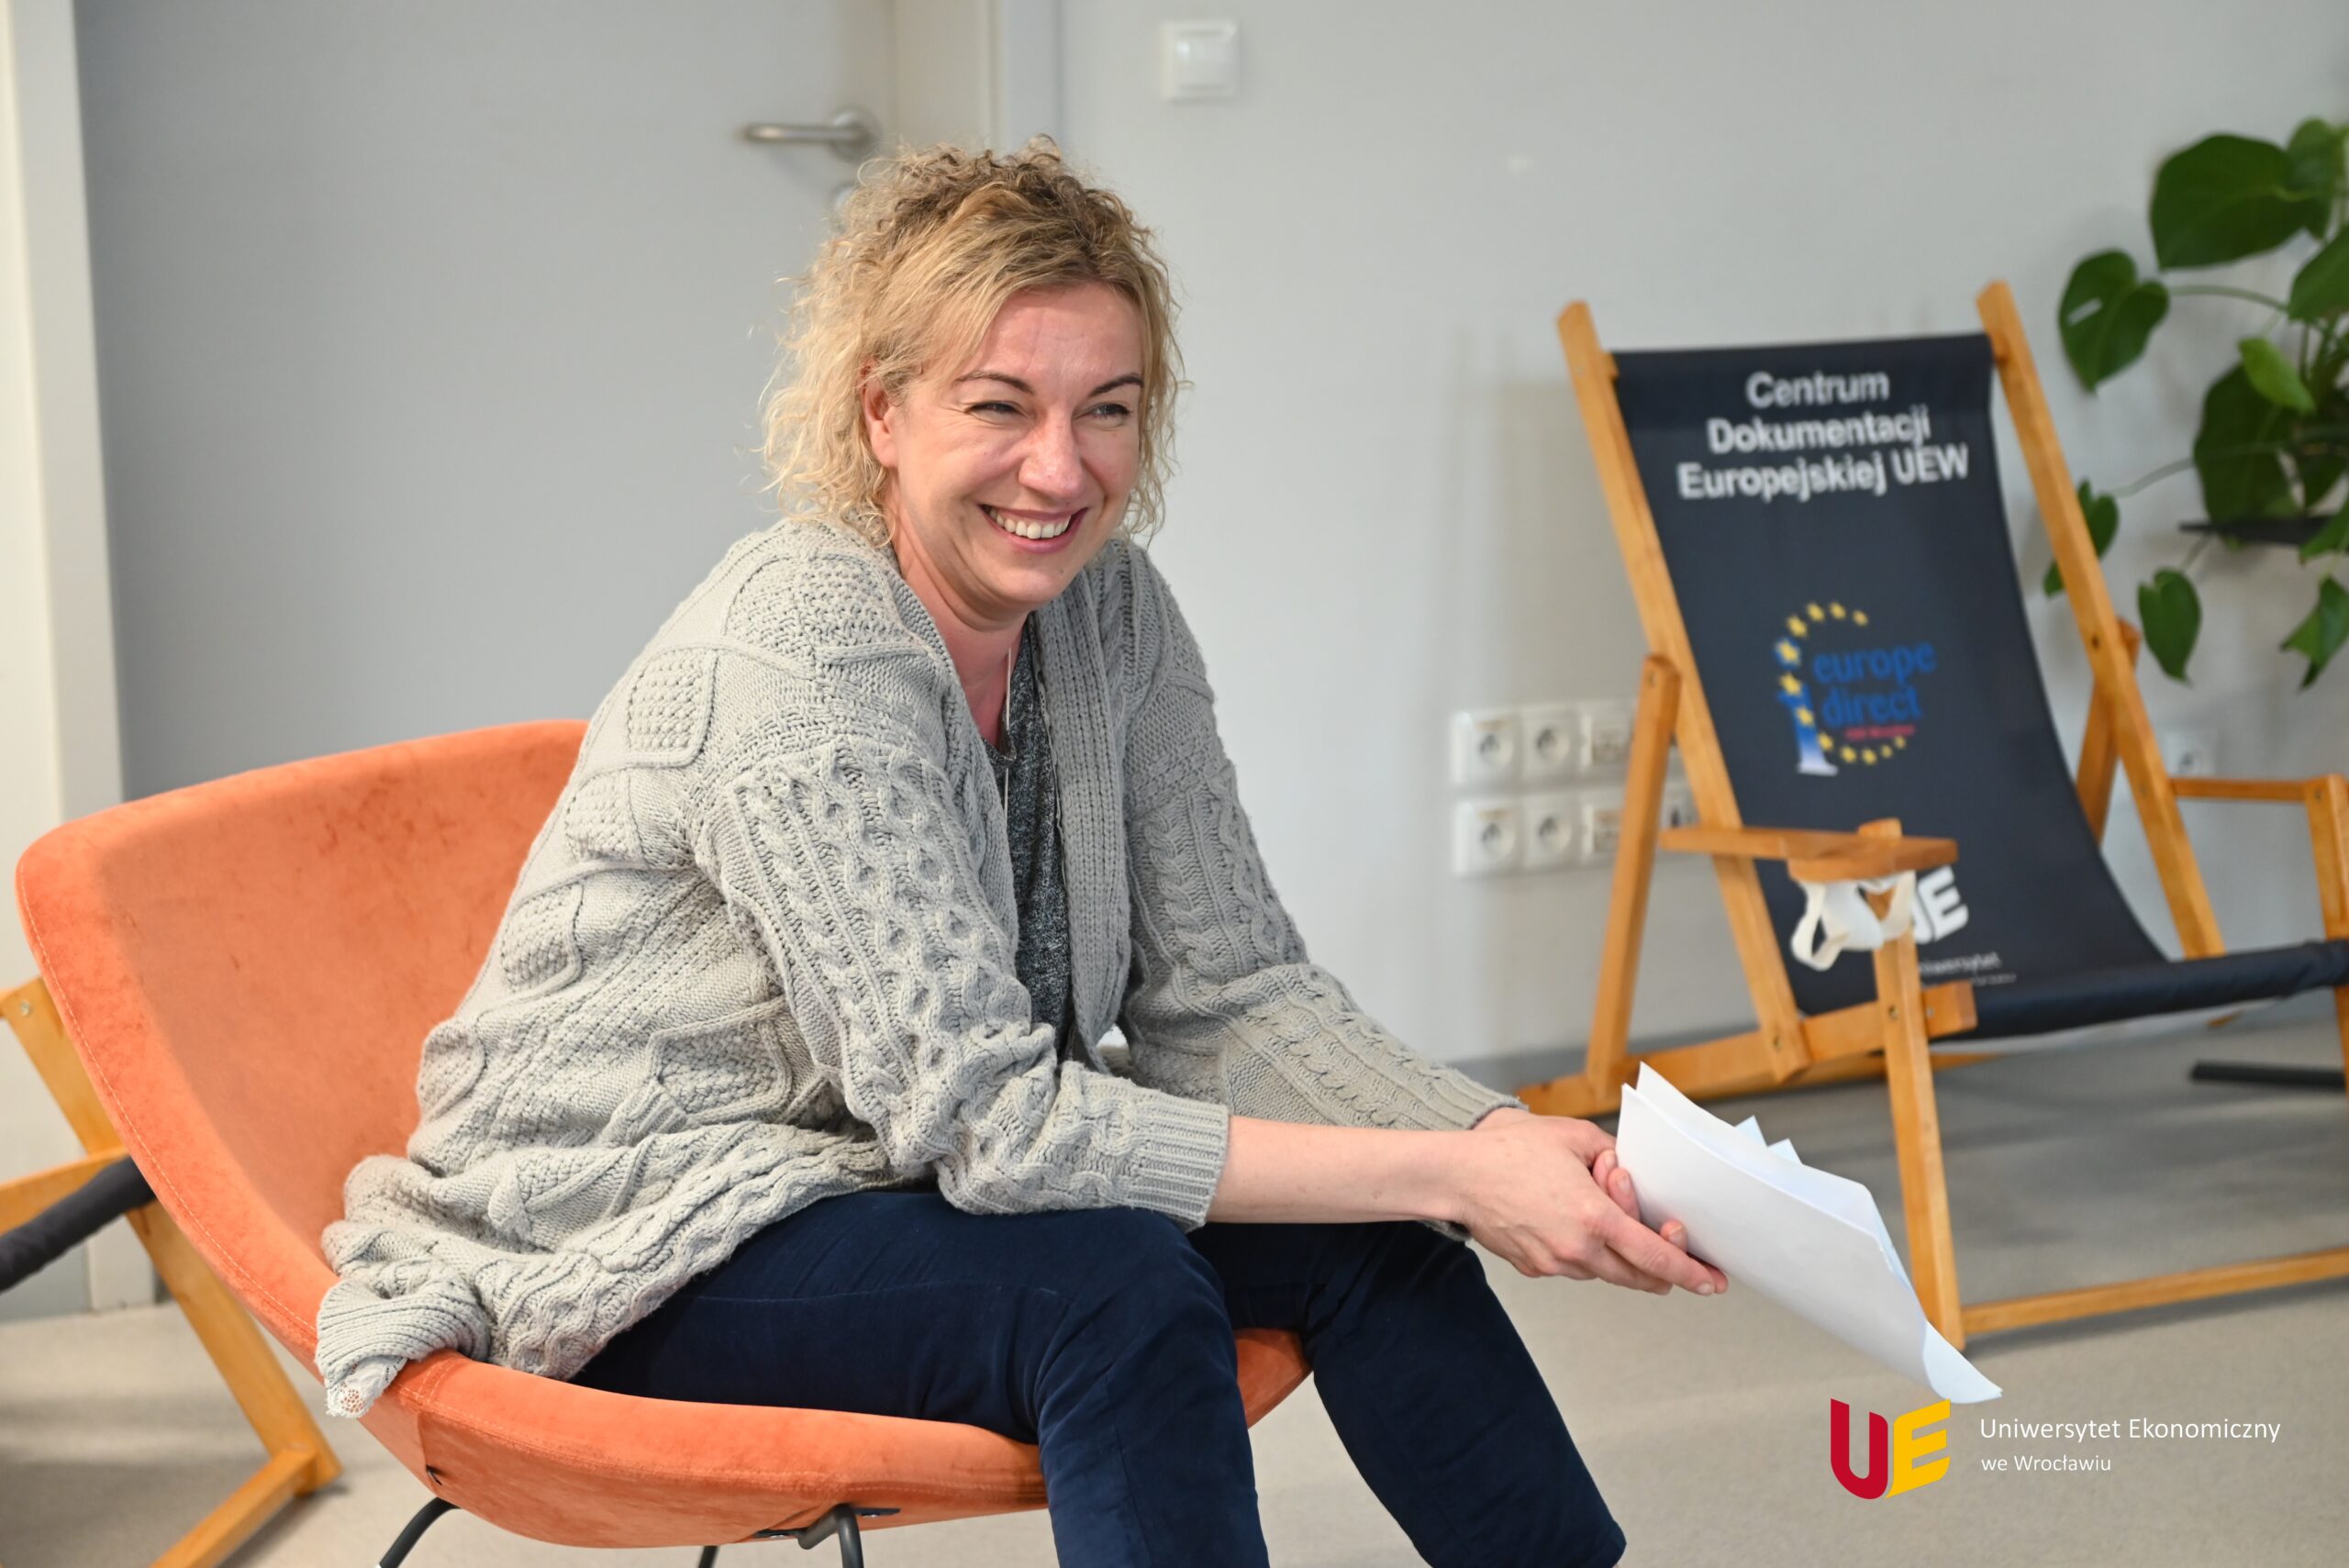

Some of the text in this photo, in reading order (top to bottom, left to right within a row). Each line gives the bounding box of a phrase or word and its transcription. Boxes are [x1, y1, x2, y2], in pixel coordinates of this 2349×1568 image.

[1745, 371, 1890, 409] Centrum
[1706, 406, 1932, 454] Dokumentacji
[1676, 442, 1970, 503] Europejskiej UEW
[1812, 640, 1938, 689] europe
[1821, 686, 1924, 728] direct
